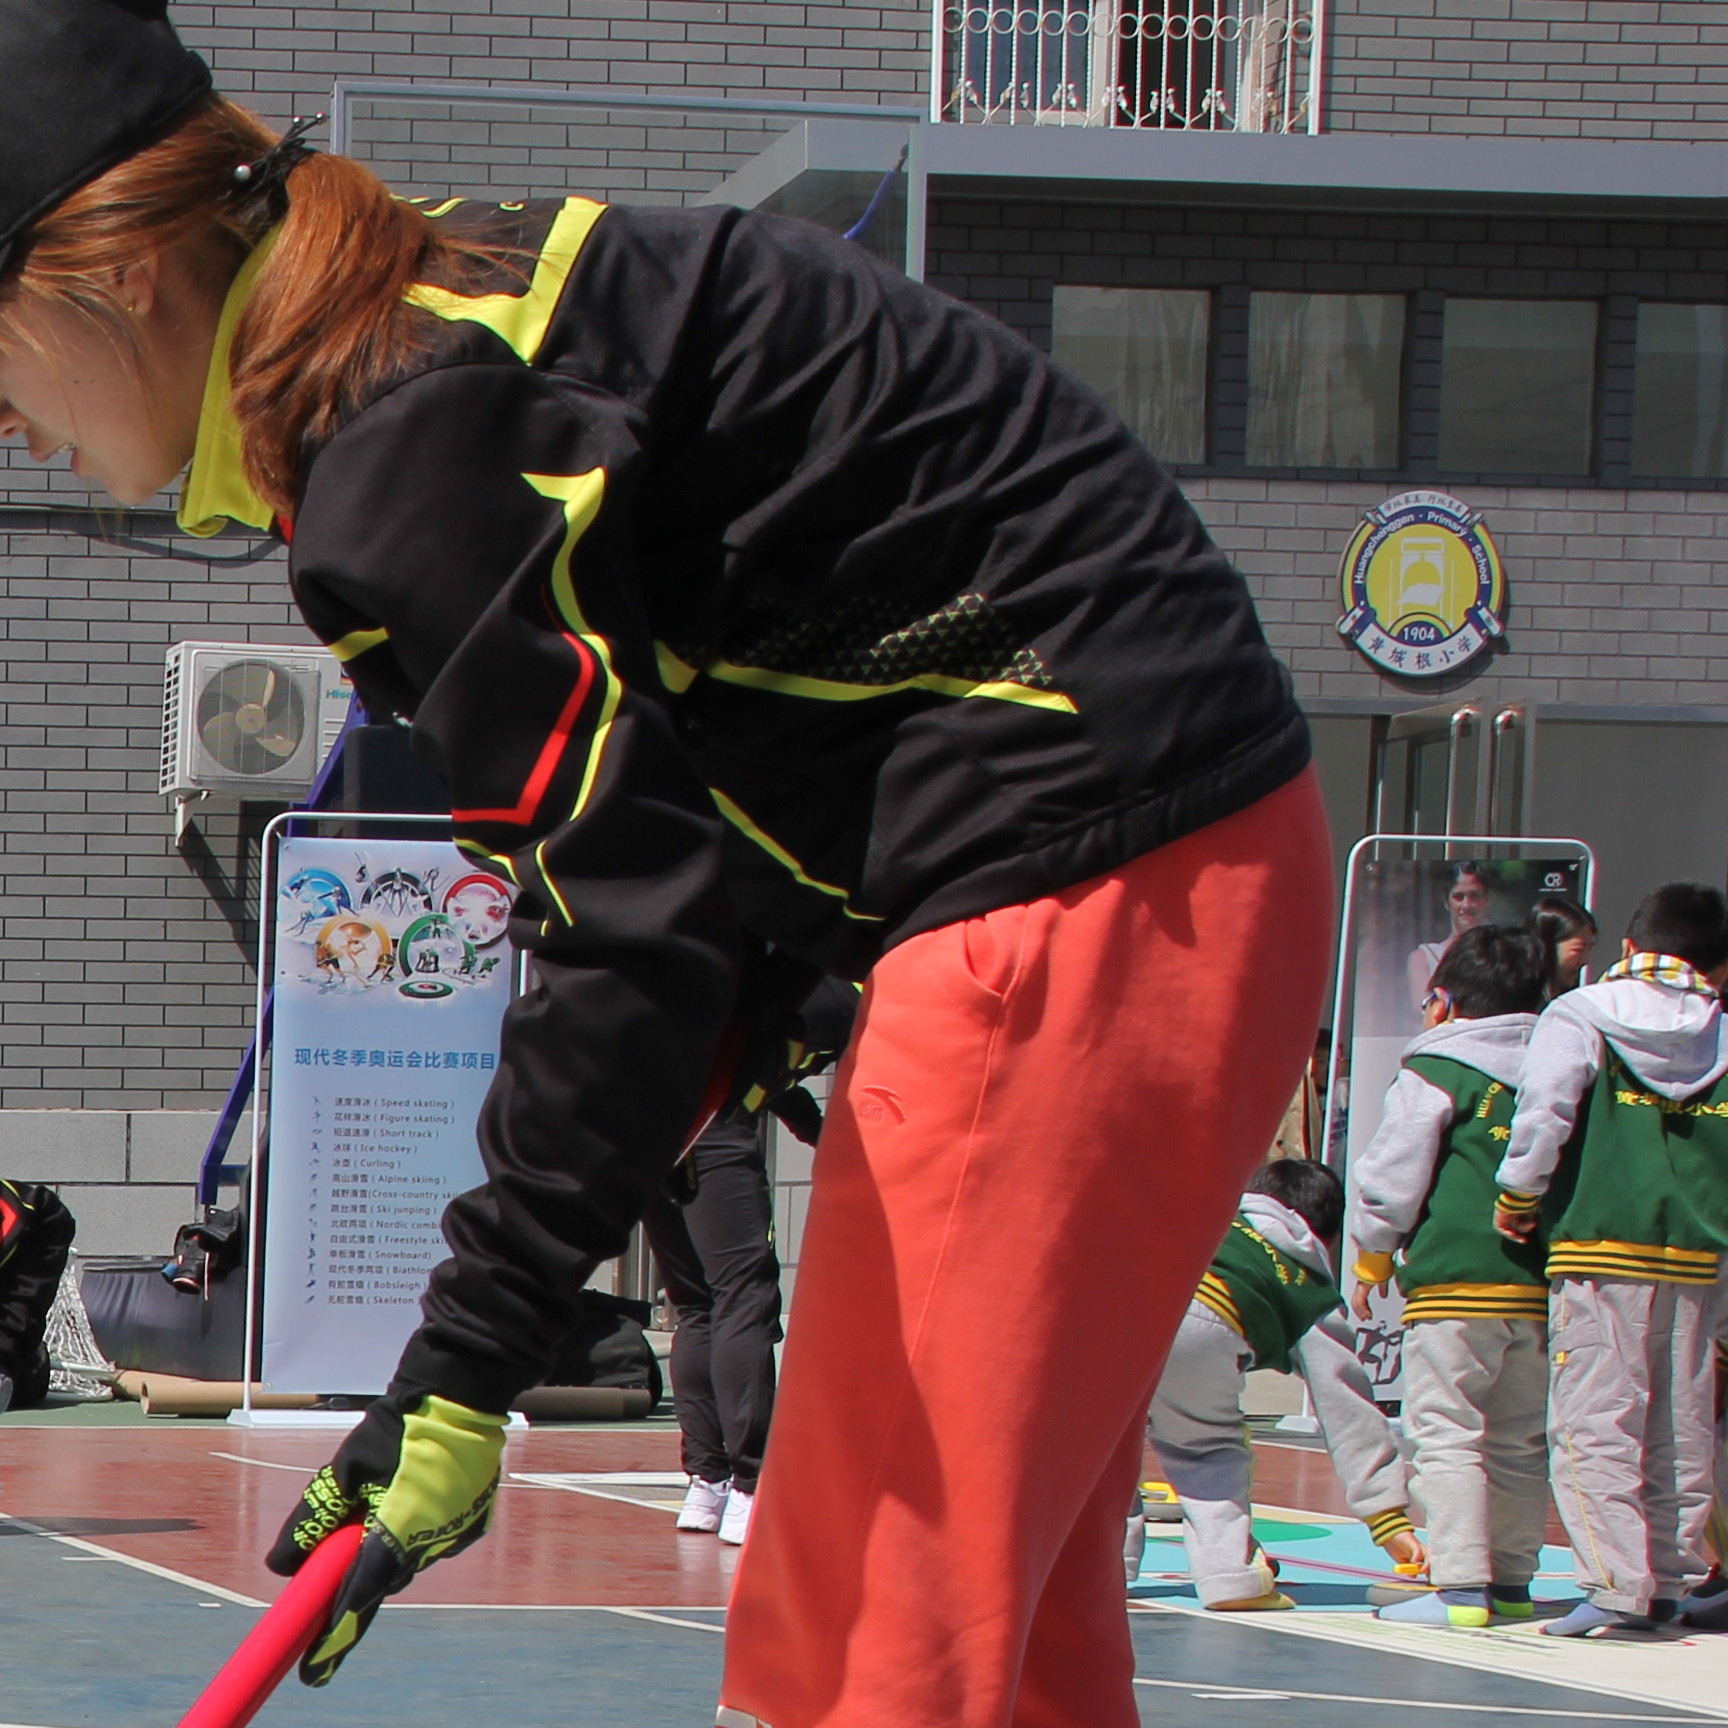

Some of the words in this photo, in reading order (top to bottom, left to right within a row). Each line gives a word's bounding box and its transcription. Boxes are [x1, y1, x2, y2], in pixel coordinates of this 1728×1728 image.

[1354, 513, 1415, 584] Huangchenggen
[1427, 511, 1468, 537] Primary
[1471, 544, 1490, 584] School
[1403, 627, 1436, 641] 1904
[1368, 636, 1472, 670] 黄城根小学
[295, 1048, 495, 1070] 现代冬季奥运会比赛项目
